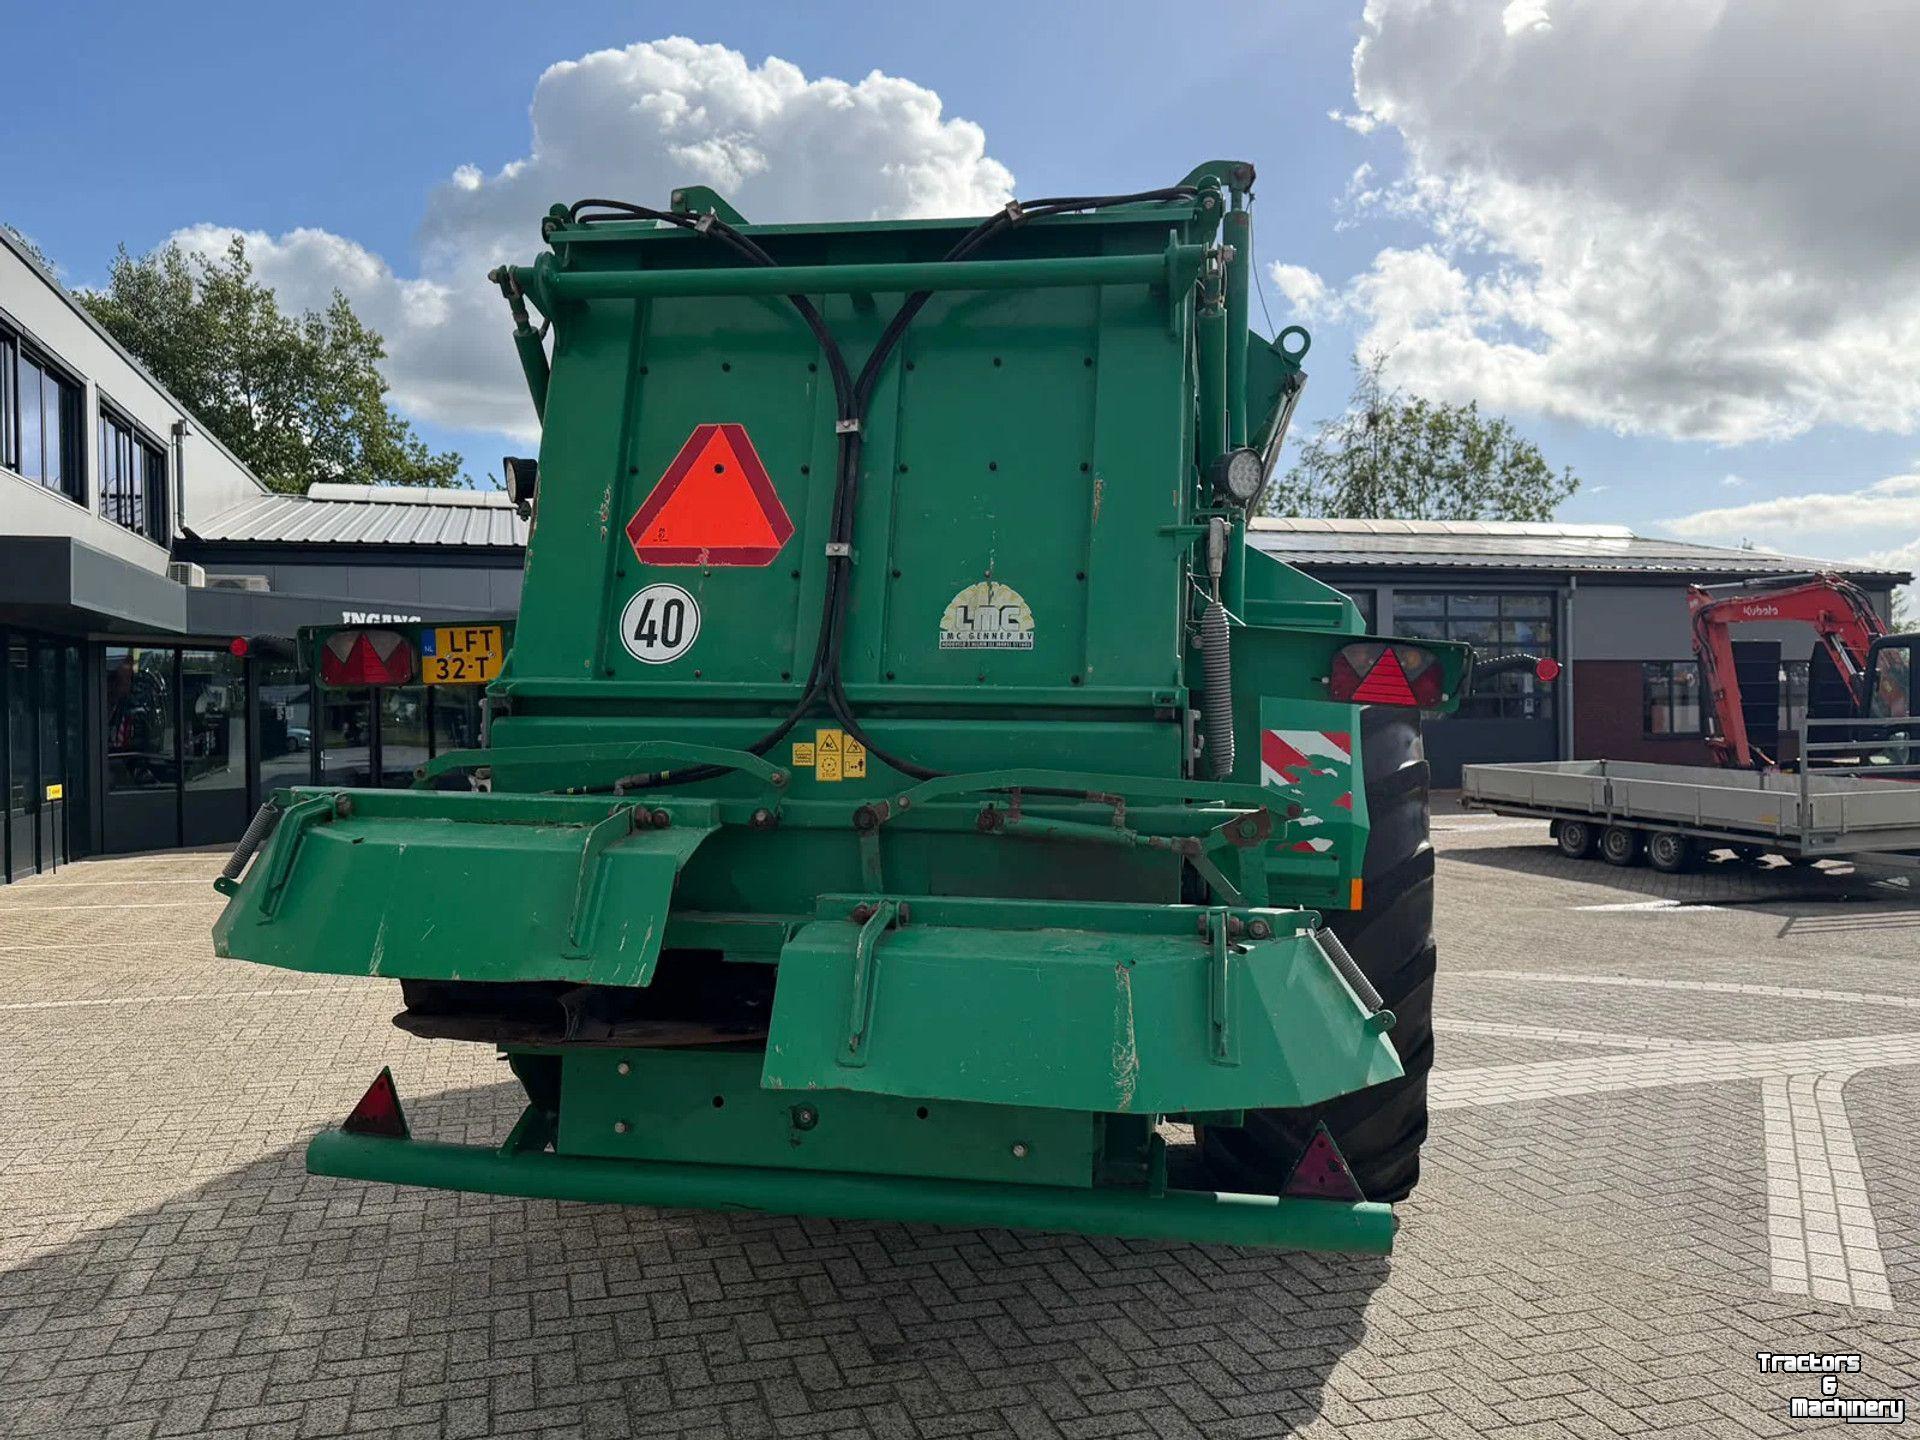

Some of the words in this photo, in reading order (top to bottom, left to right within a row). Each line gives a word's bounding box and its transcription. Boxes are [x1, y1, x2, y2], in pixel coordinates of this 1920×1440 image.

[1743, 604, 1779, 616] Kubota
[634, 598, 685, 648] 40
[424, 645, 434, 653] NL
[449, 629, 493, 652] LFT
[436, 656, 490, 680] 32-T
